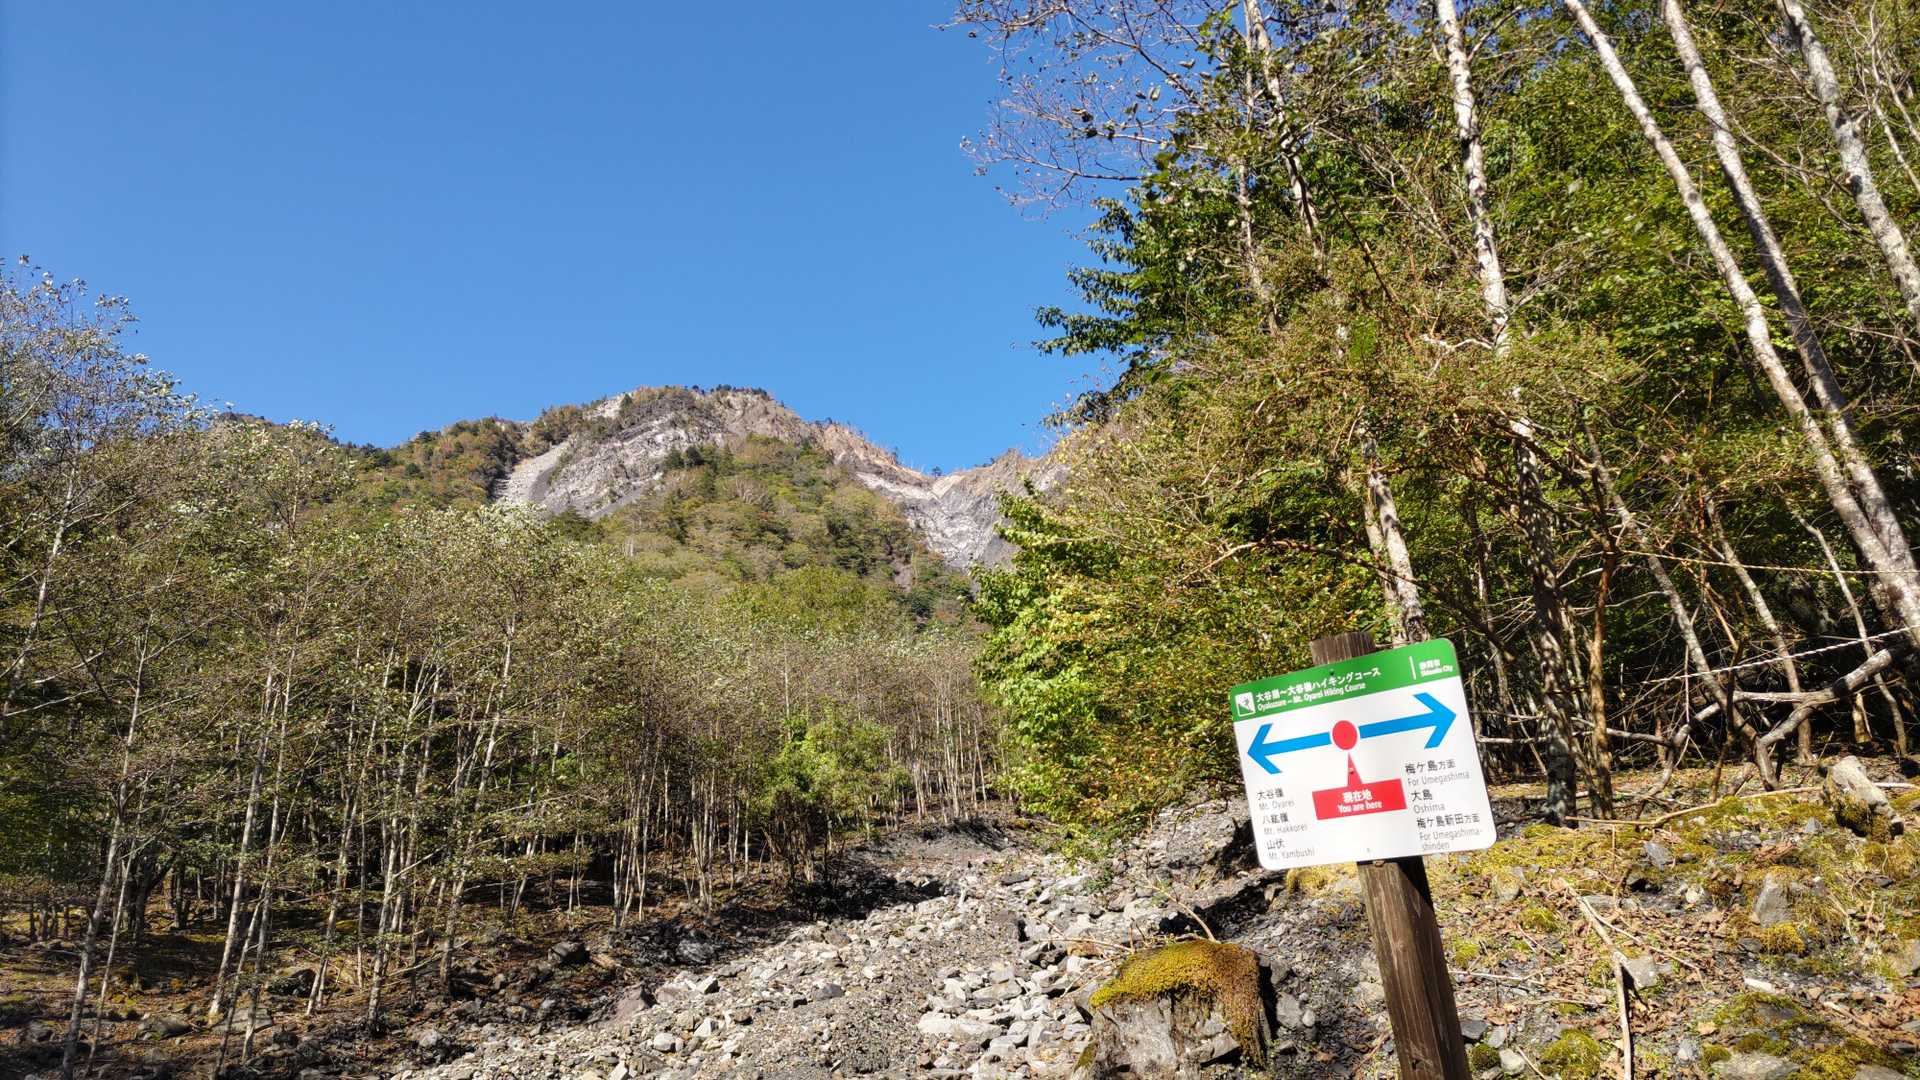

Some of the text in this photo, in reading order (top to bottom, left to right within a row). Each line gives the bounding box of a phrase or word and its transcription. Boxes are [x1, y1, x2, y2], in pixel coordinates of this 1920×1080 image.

[1324, 686, 1344, 697] Hiking
[1344, 682, 1367, 693] Course
[1408, 770, 1470, 786] For Umegashima
[1343, 788, 1373, 803] 現在地
[1411, 788, 1433, 802] 大島
[1258, 801, 1269, 810] Mt.
[1337, 800, 1382, 814] You are here
[1413, 803, 1445, 814] Oshima
[1263, 825, 1274, 835] Mt.
[1419, 831, 1431, 841] For
[1266, 838, 1285, 850] 山伏
[1422, 841, 1450, 851] shinden
[1268, 851, 1278, 860] Mt.
